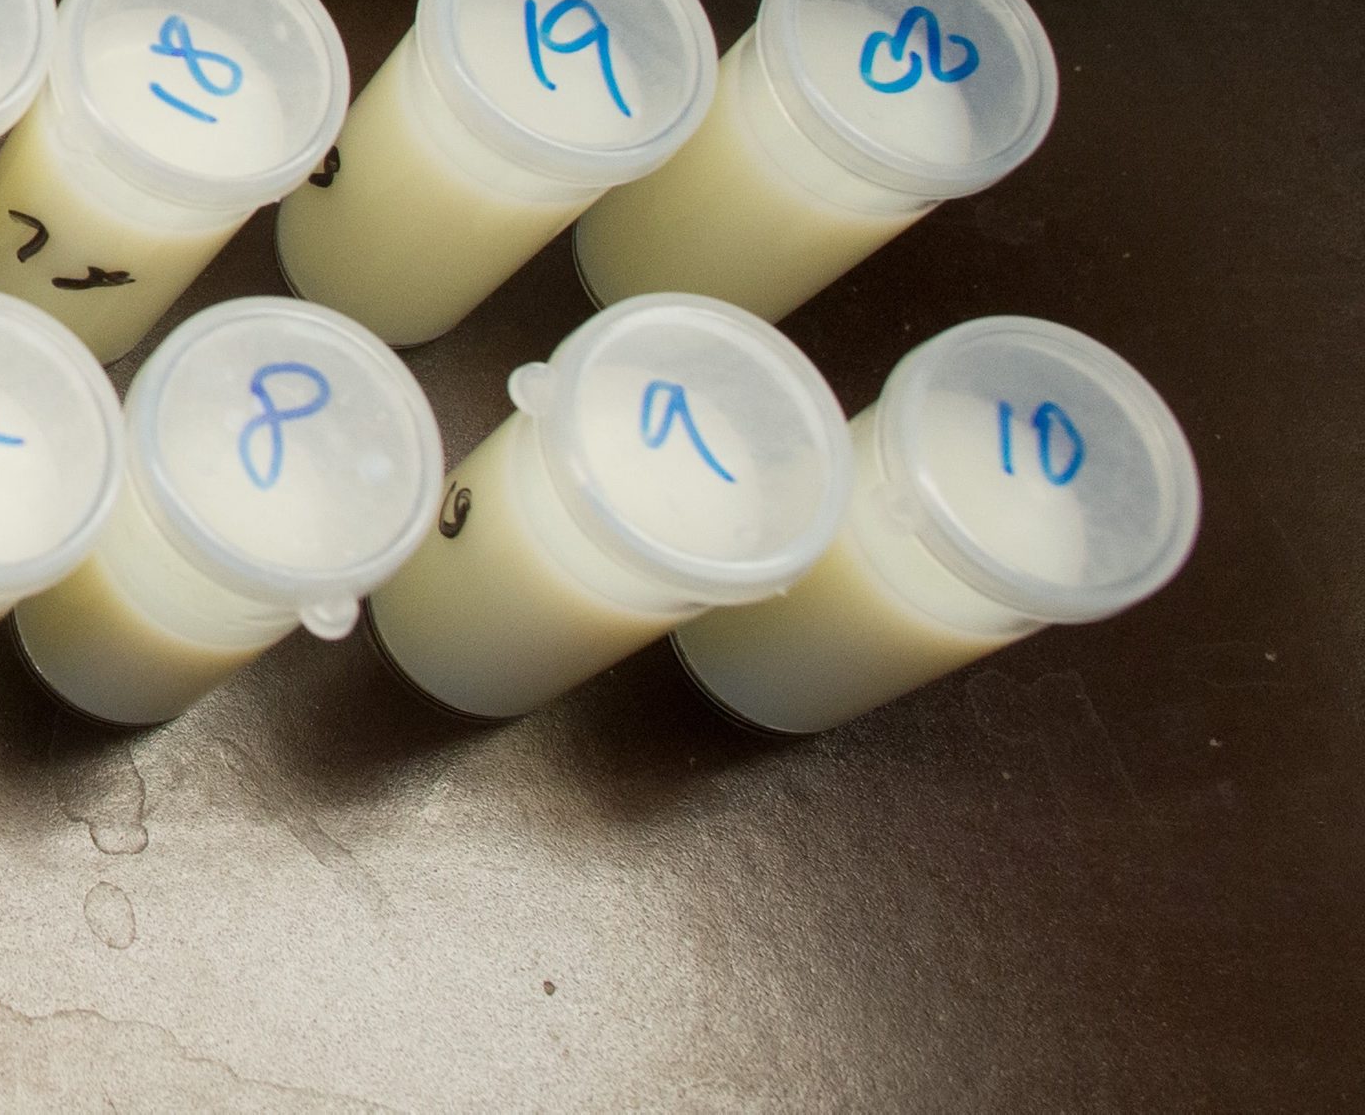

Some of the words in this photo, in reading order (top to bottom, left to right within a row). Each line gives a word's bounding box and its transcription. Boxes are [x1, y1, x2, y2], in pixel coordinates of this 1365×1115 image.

[148, 15, 243, 124] 18
[239, 362, 331, 489] 8
[640, 380, 736, 484] 9
[996, 399, 1088, 488] 10
